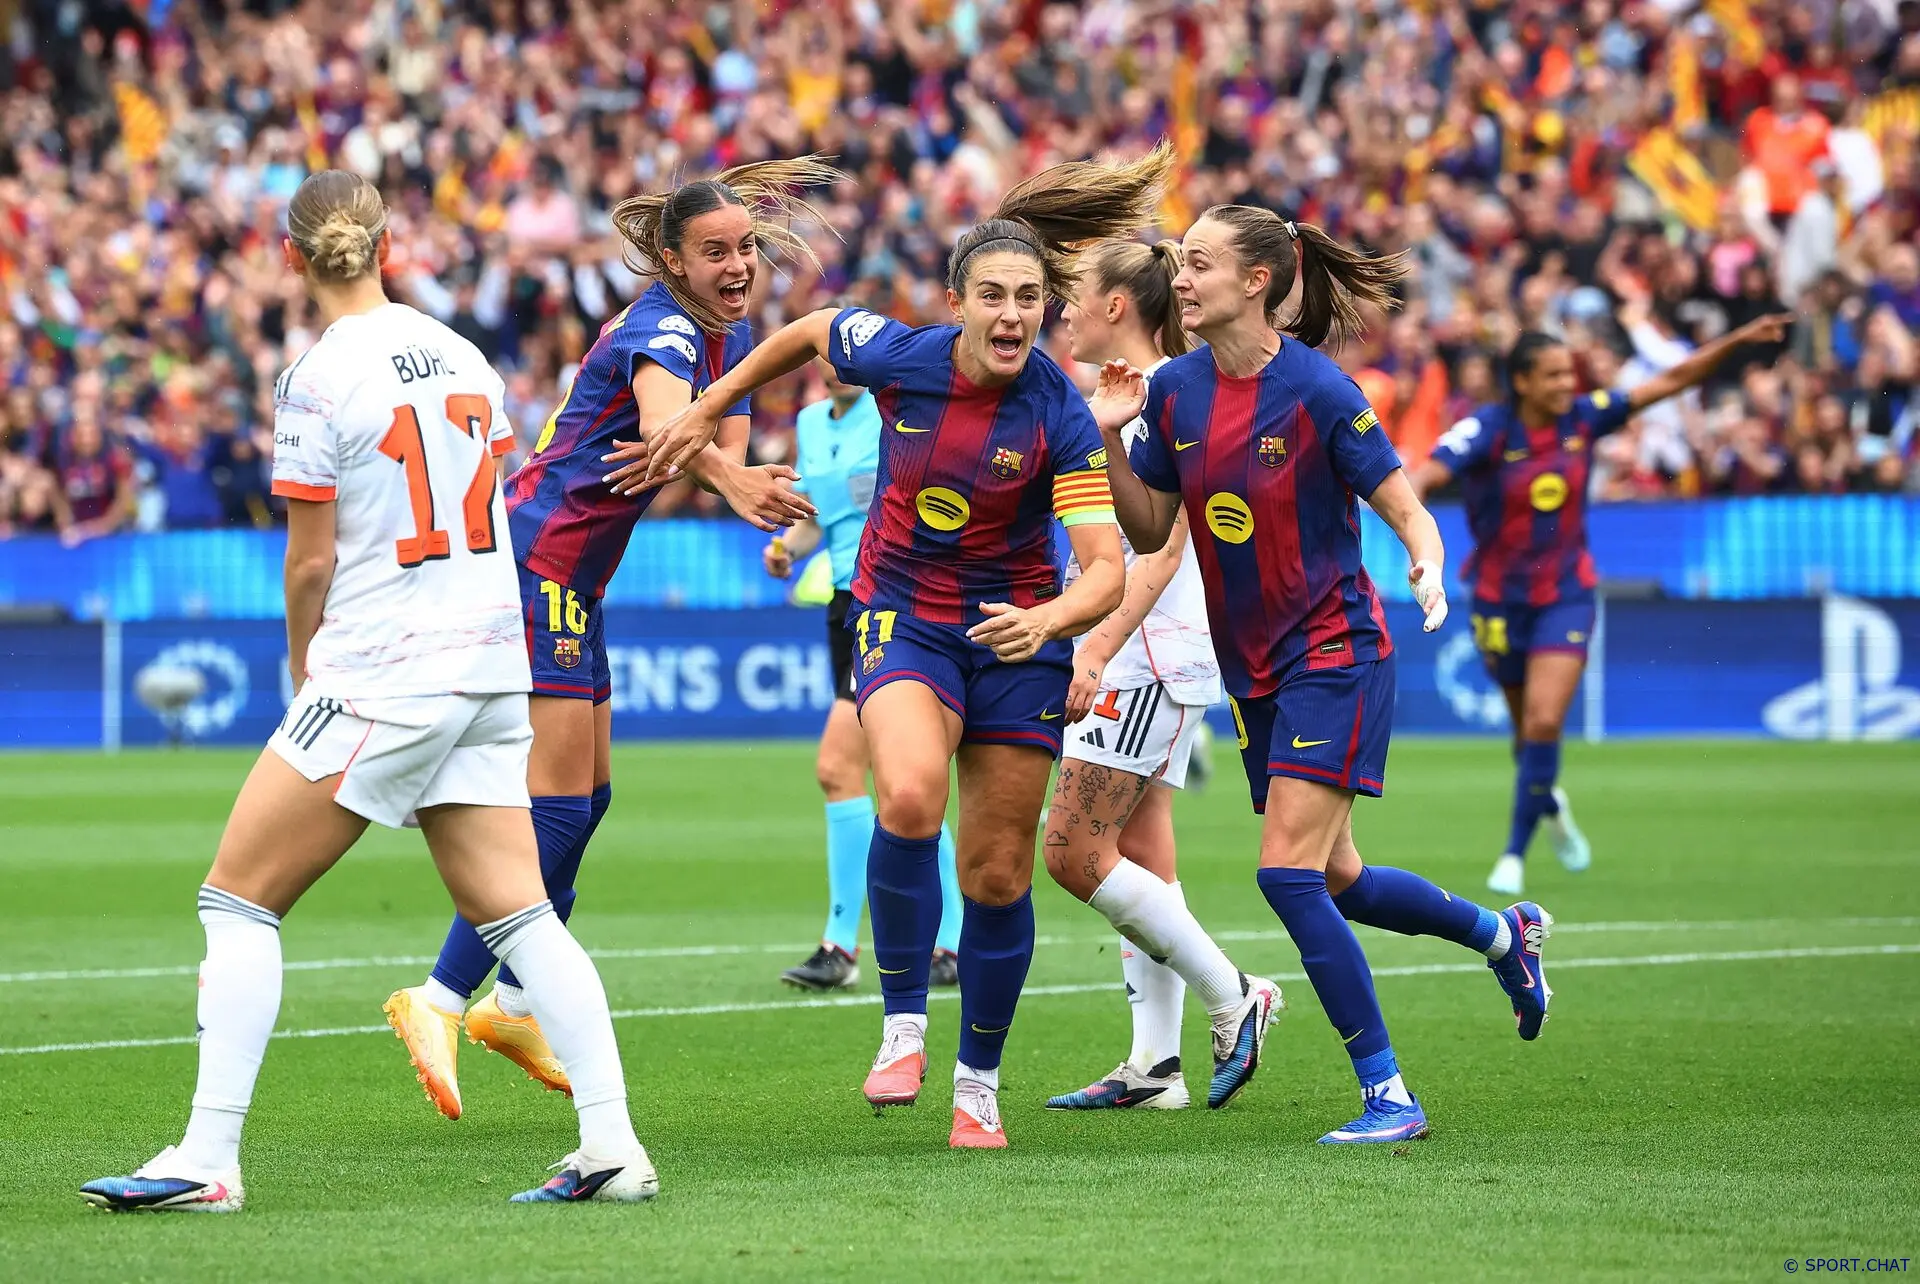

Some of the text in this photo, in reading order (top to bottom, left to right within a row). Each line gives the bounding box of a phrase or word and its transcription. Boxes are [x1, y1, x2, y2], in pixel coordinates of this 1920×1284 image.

[391, 344, 456, 384] BÜHL
[378, 392, 497, 568] 17
[540, 580, 588, 634] 16
[1089, 820, 1109, 837] 31
